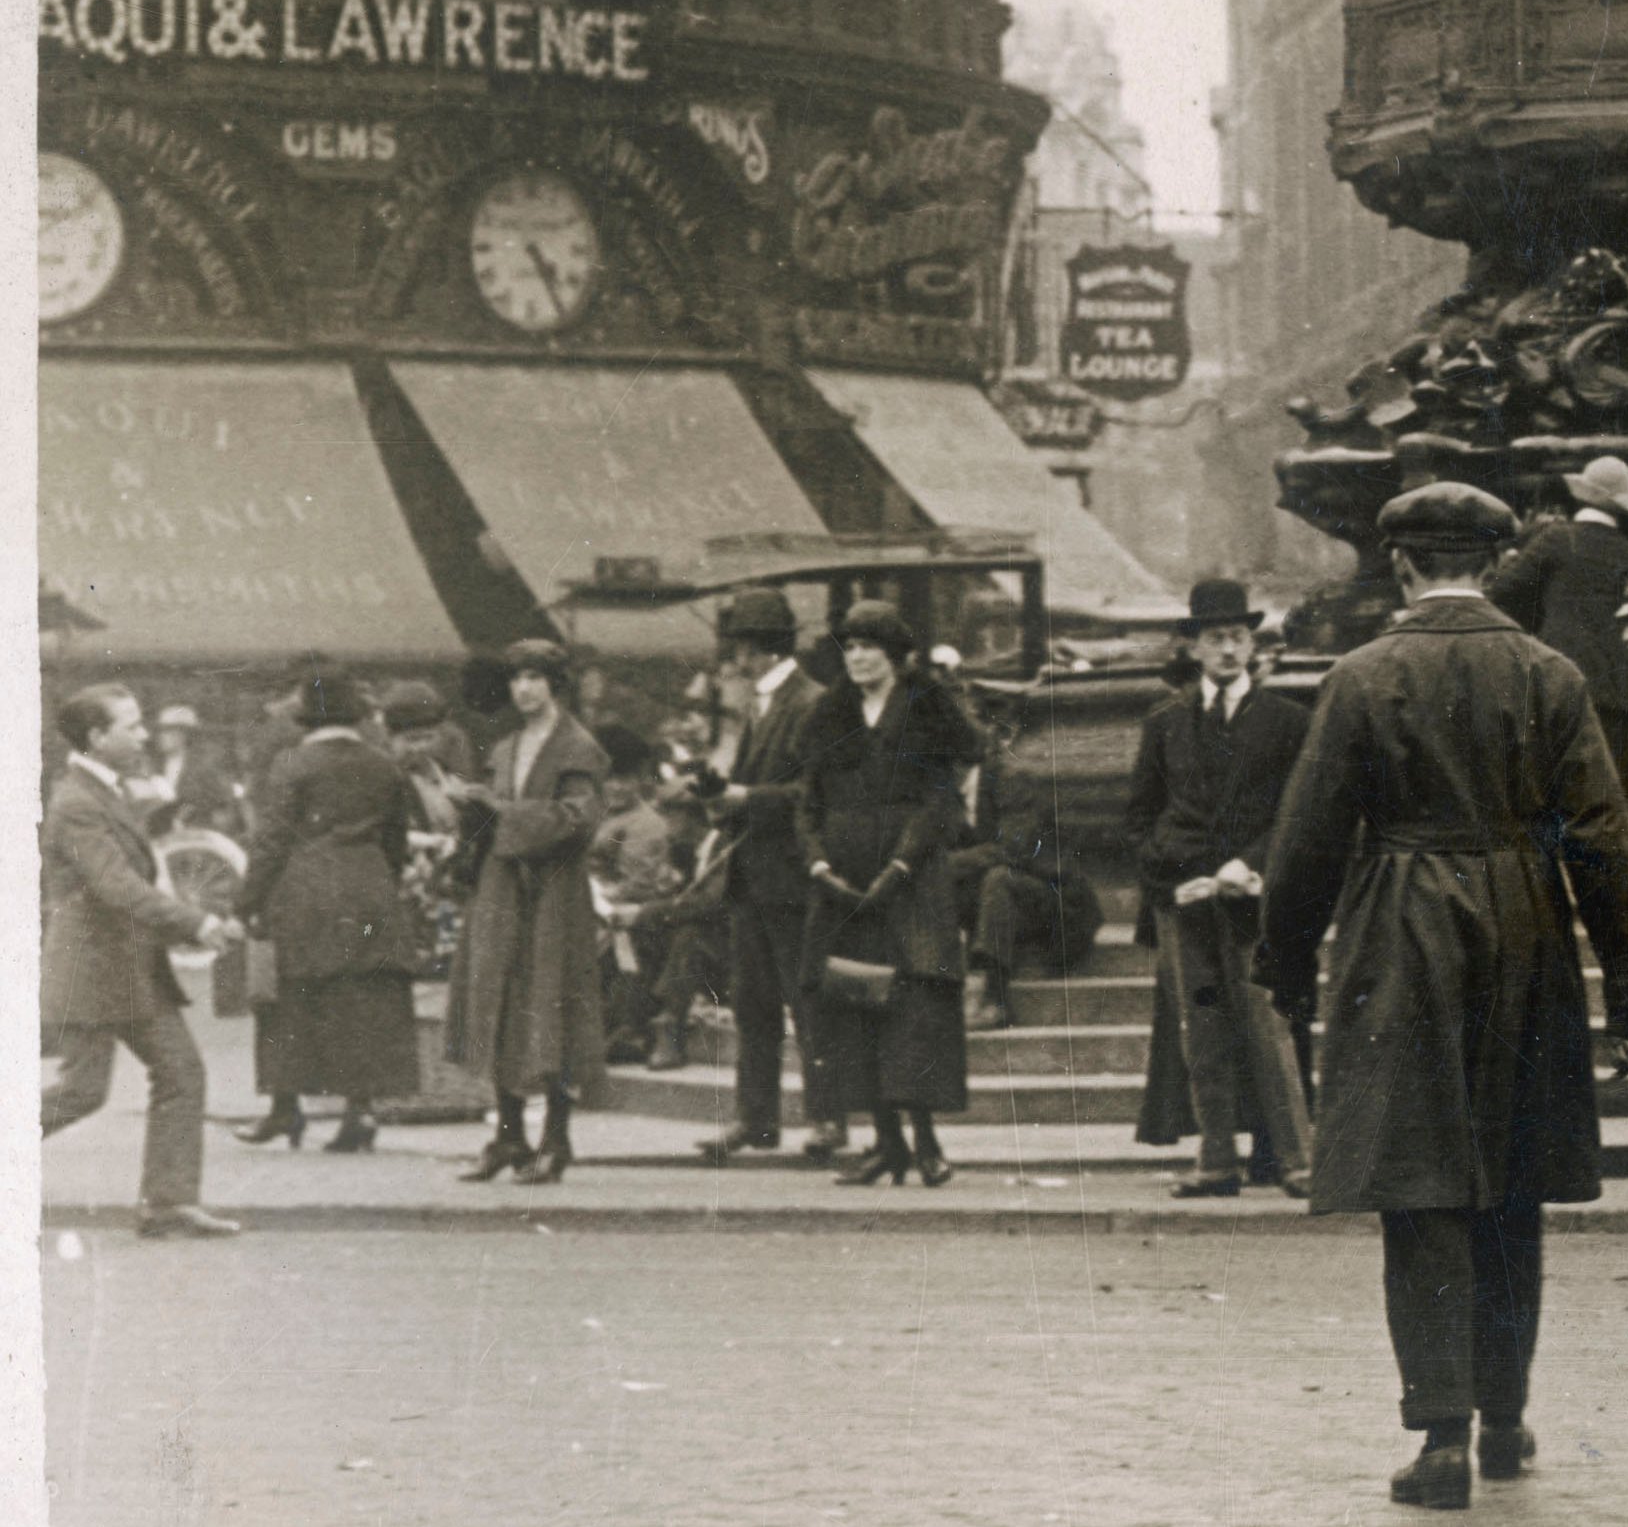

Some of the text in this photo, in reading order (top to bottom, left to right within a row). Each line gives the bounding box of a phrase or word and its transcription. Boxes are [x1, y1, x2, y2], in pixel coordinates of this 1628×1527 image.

[282, 121, 398, 161] GEMS
[1095, 325, 1154, 350] TEA
[1069, 352, 1179, 381] LOUNGE
